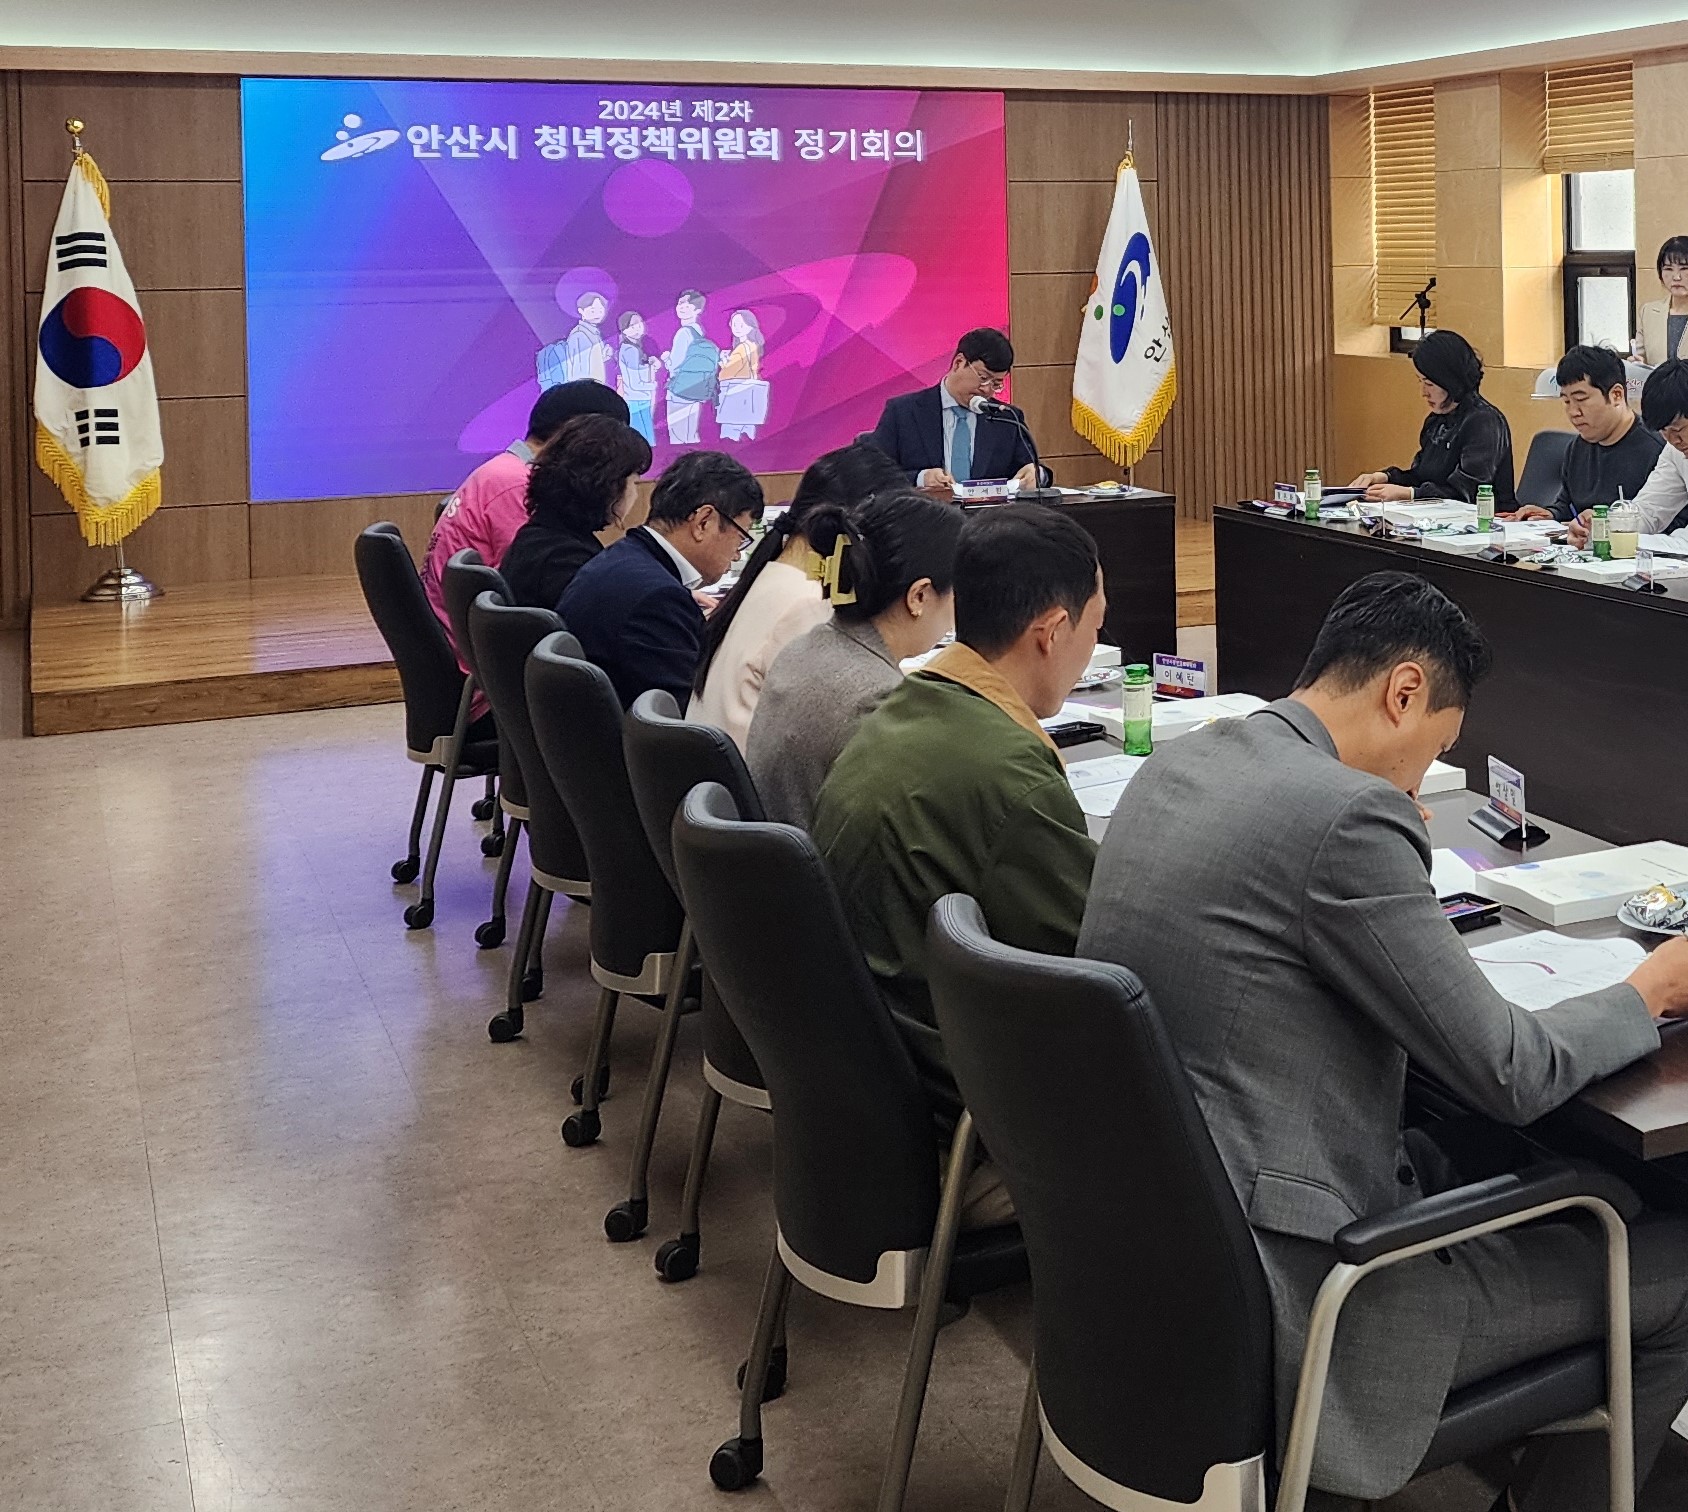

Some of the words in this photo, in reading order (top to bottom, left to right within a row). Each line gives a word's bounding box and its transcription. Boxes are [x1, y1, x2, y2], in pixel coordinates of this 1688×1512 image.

[598, 100, 683, 122] 2024년
[691, 100, 753, 122] 제2차
[406, 125, 518, 160] 안산시
[534, 125, 780, 162] 청년정책위원회
[794, 129, 924, 162] 정기회의
